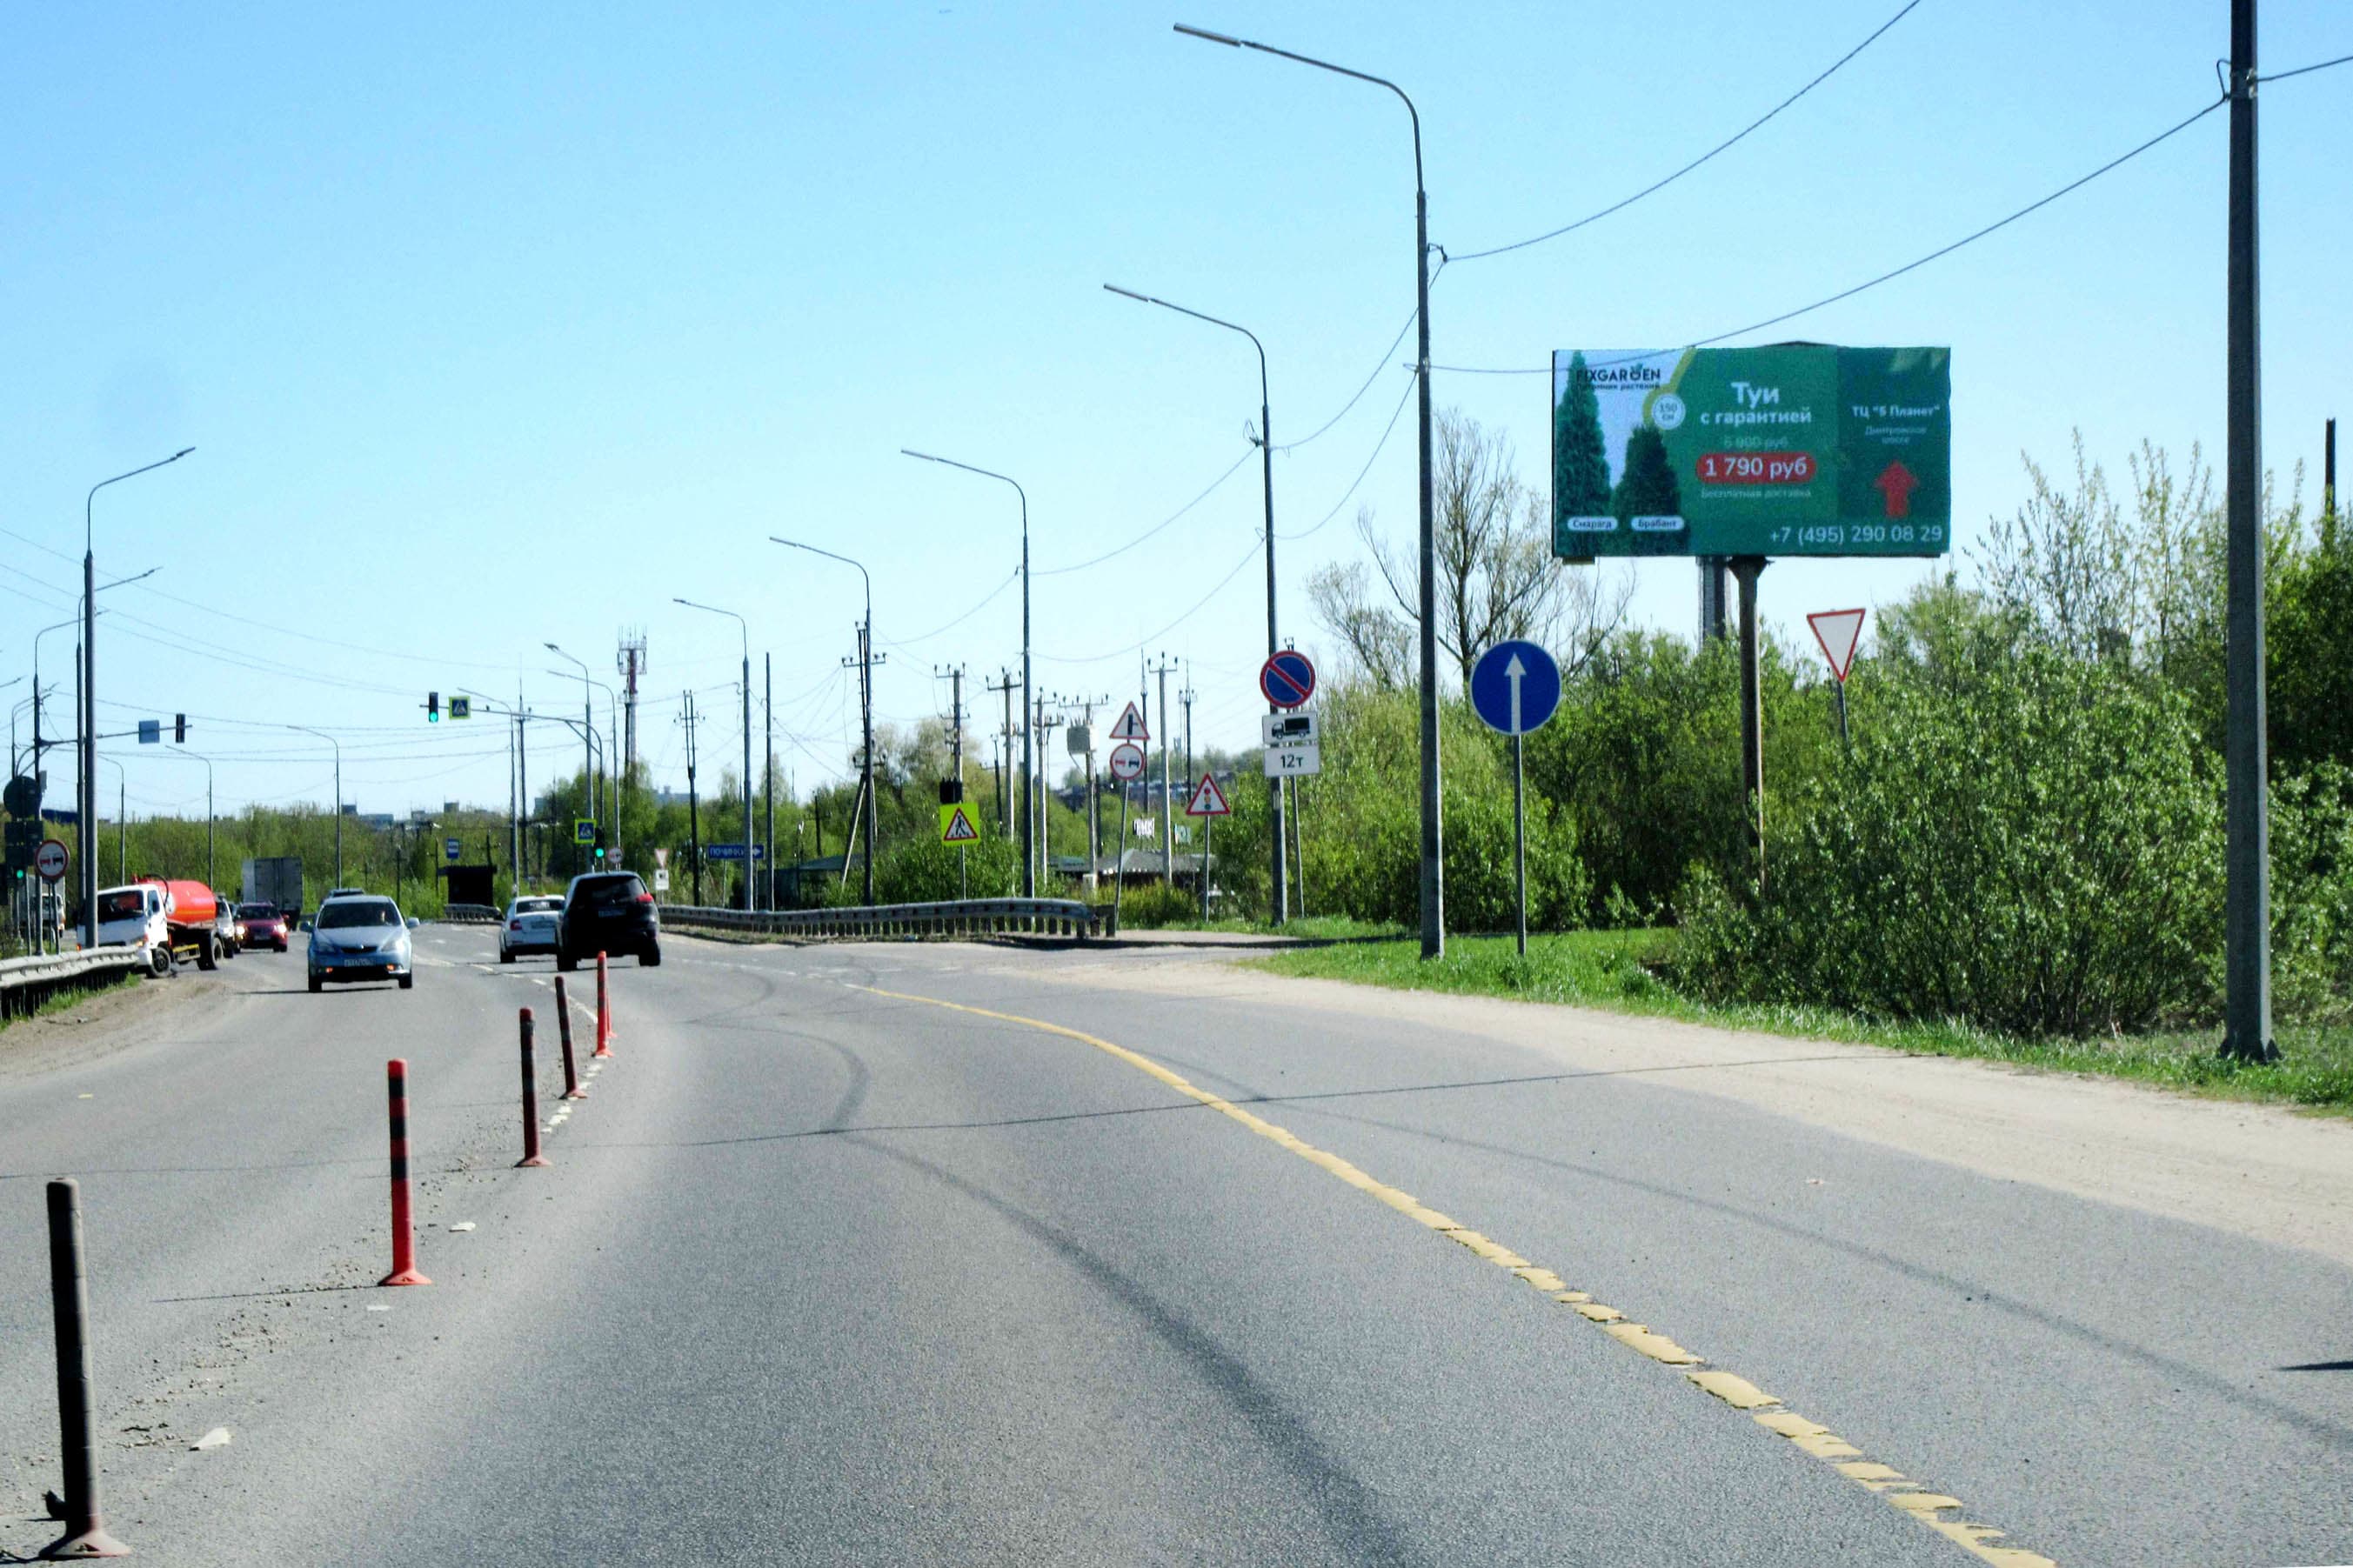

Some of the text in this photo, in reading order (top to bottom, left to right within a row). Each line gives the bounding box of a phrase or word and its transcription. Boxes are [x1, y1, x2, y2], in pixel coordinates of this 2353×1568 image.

[1730, 381, 1780, 410] Туи
[1700, 406, 1812, 427] с гарантией
[1851, 405, 1869, 420] ТЦ
[1890, 404, 1941, 417] Планет"
[1705, 456, 1808, 479] 1 790 руб
[1770, 525, 1943, 546] +7 (495) 290 08 29
[1280, 754, 1304, 769] 12т
